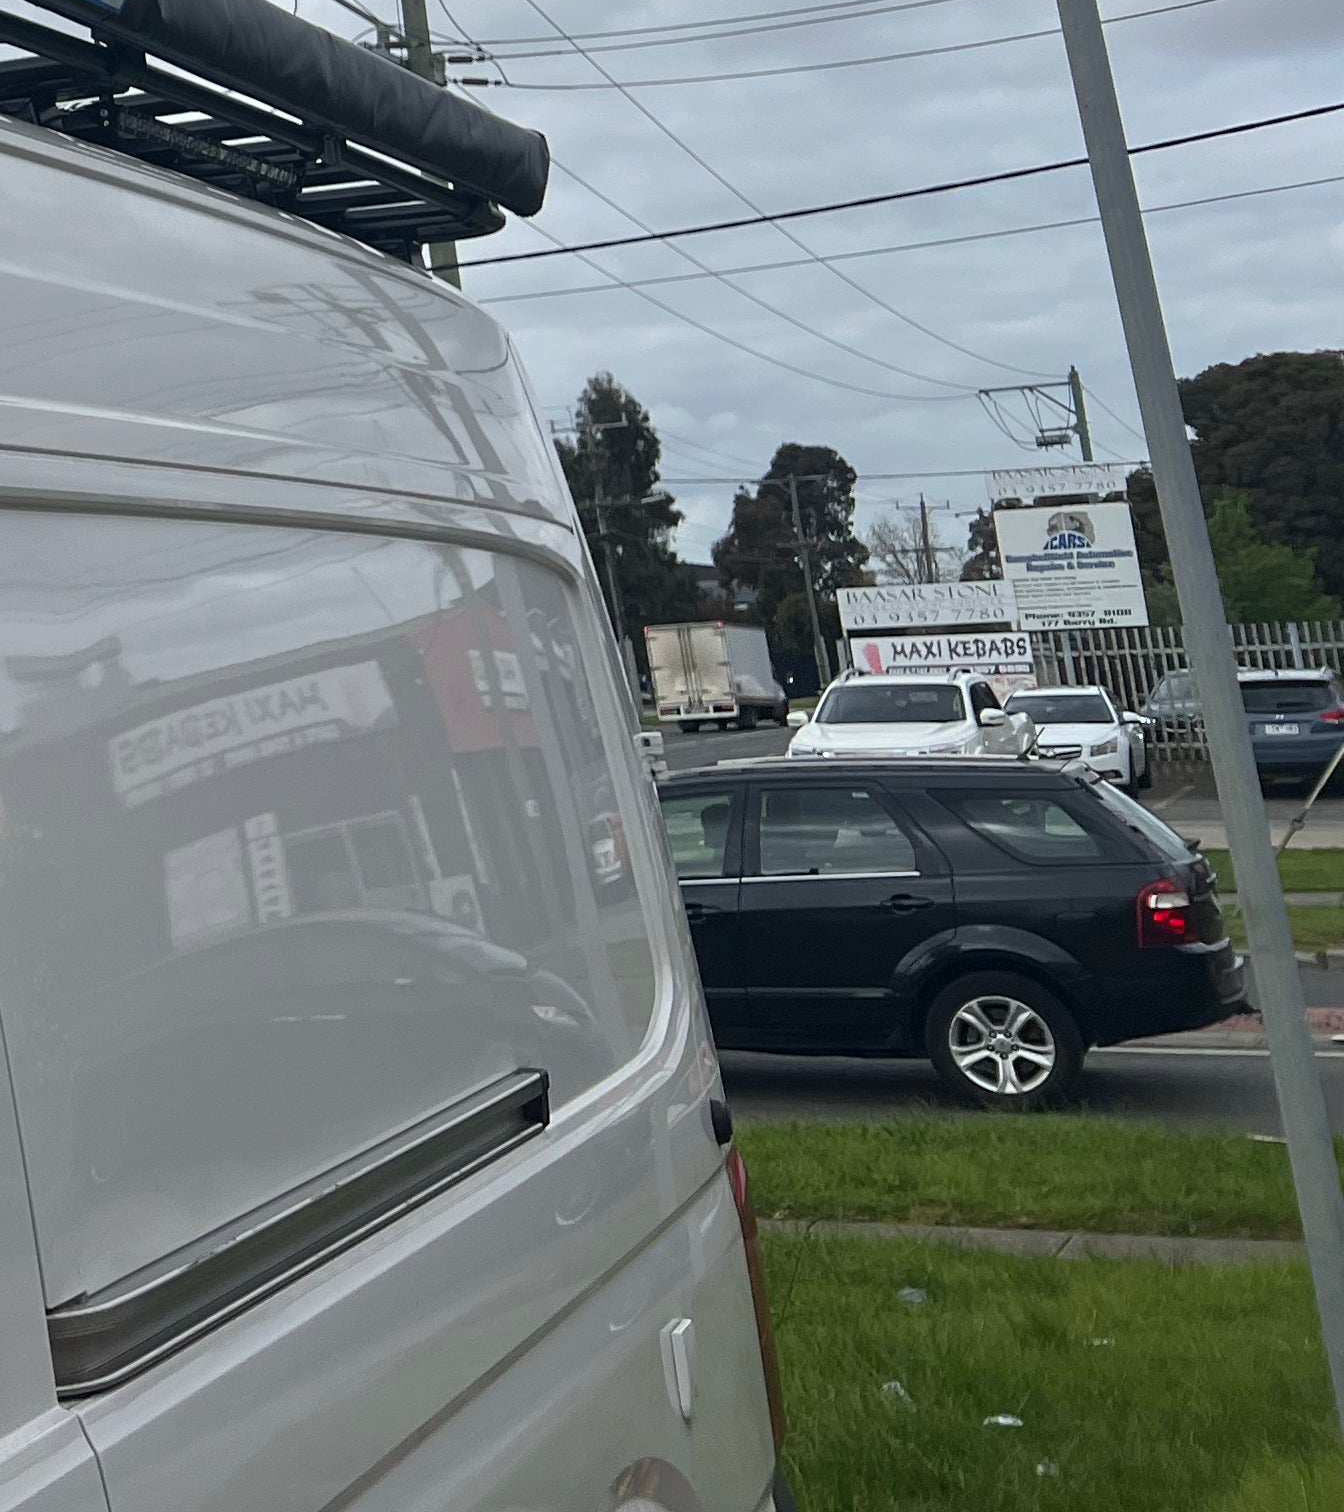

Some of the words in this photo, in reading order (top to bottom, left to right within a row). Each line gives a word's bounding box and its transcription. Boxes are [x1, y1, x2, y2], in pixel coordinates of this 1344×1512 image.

[846, 586, 926, 605] BAASAR
[853, 614, 878, 626] 03
[888, 609, 940, 624] 9357
[951, 607, 1005, 621] 7780
[890, 639, 942, 662] MAXI
[946, 636, 1028, 661] KEBABS
